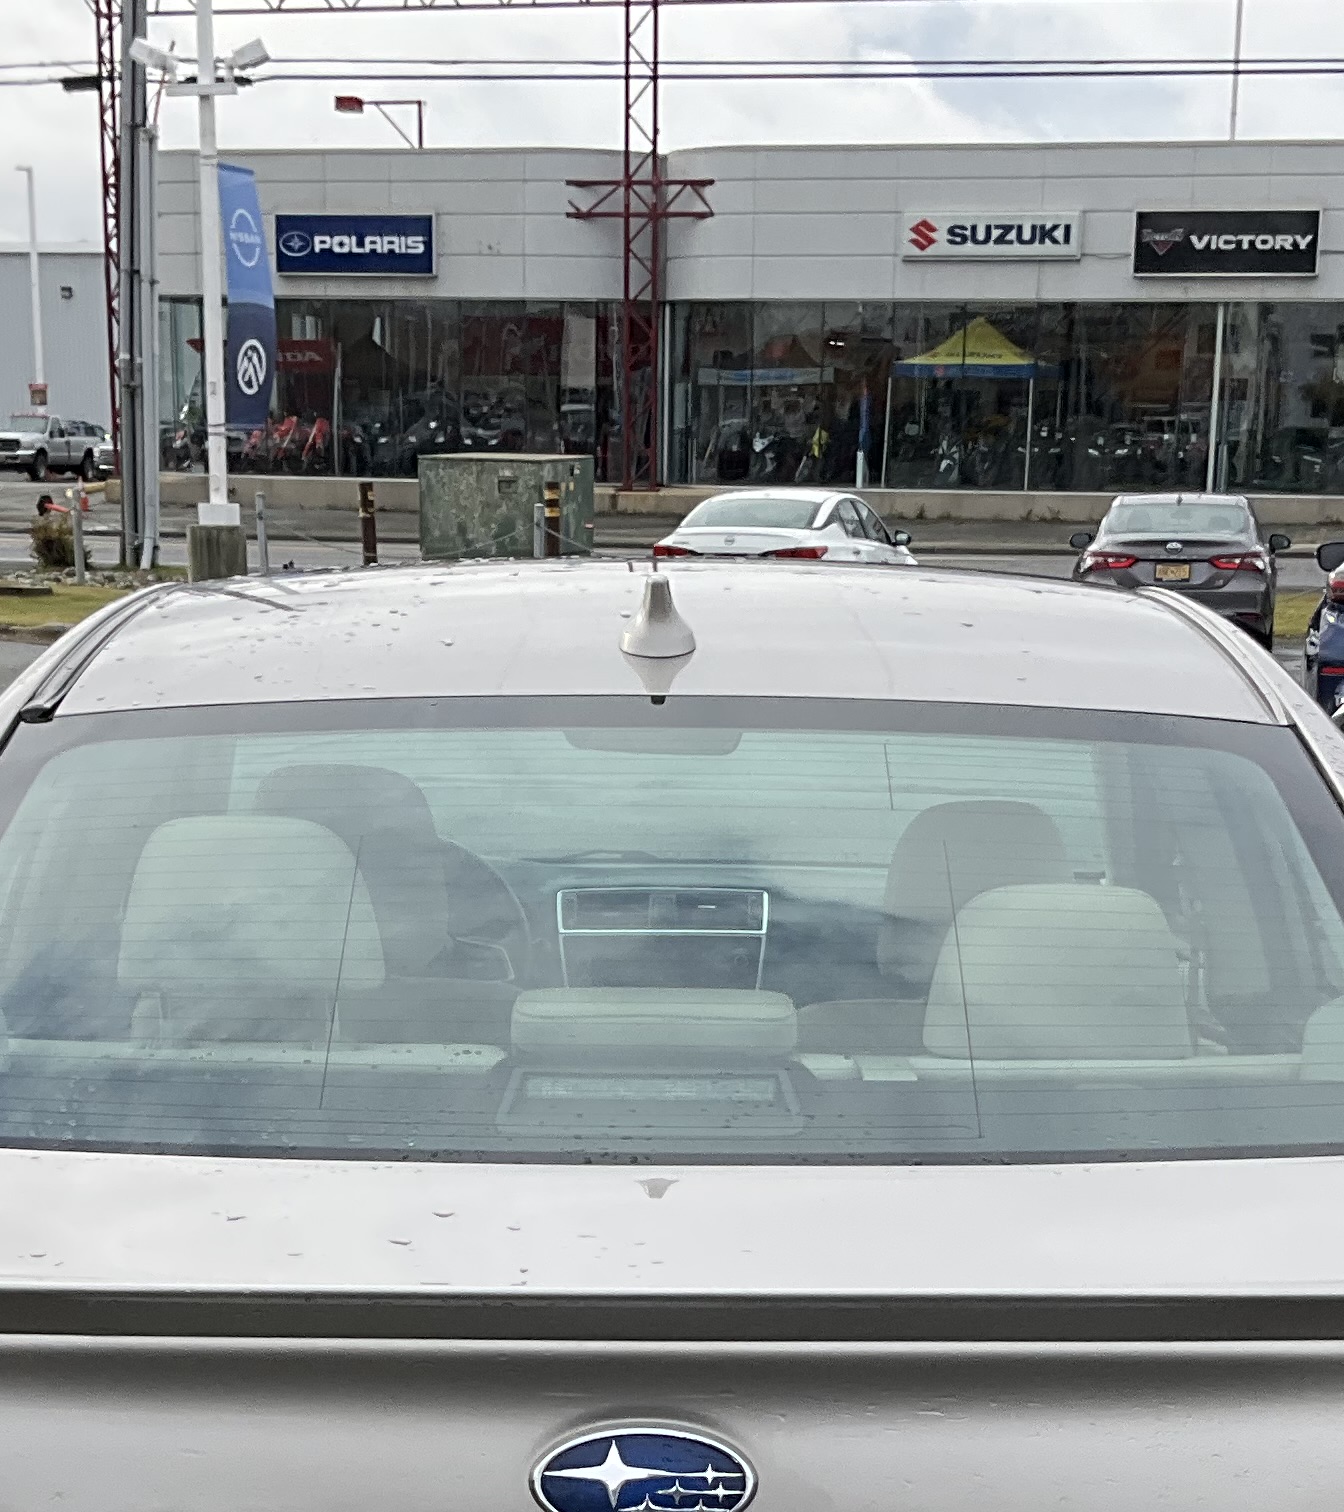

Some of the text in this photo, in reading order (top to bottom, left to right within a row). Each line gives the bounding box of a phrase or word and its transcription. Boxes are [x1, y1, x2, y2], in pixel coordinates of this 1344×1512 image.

[946, 223, 1072, 246] SUZUKI
[1188, 233, 1314, 251] VICTORY
[313, 235, 425, 255] POLARIS
